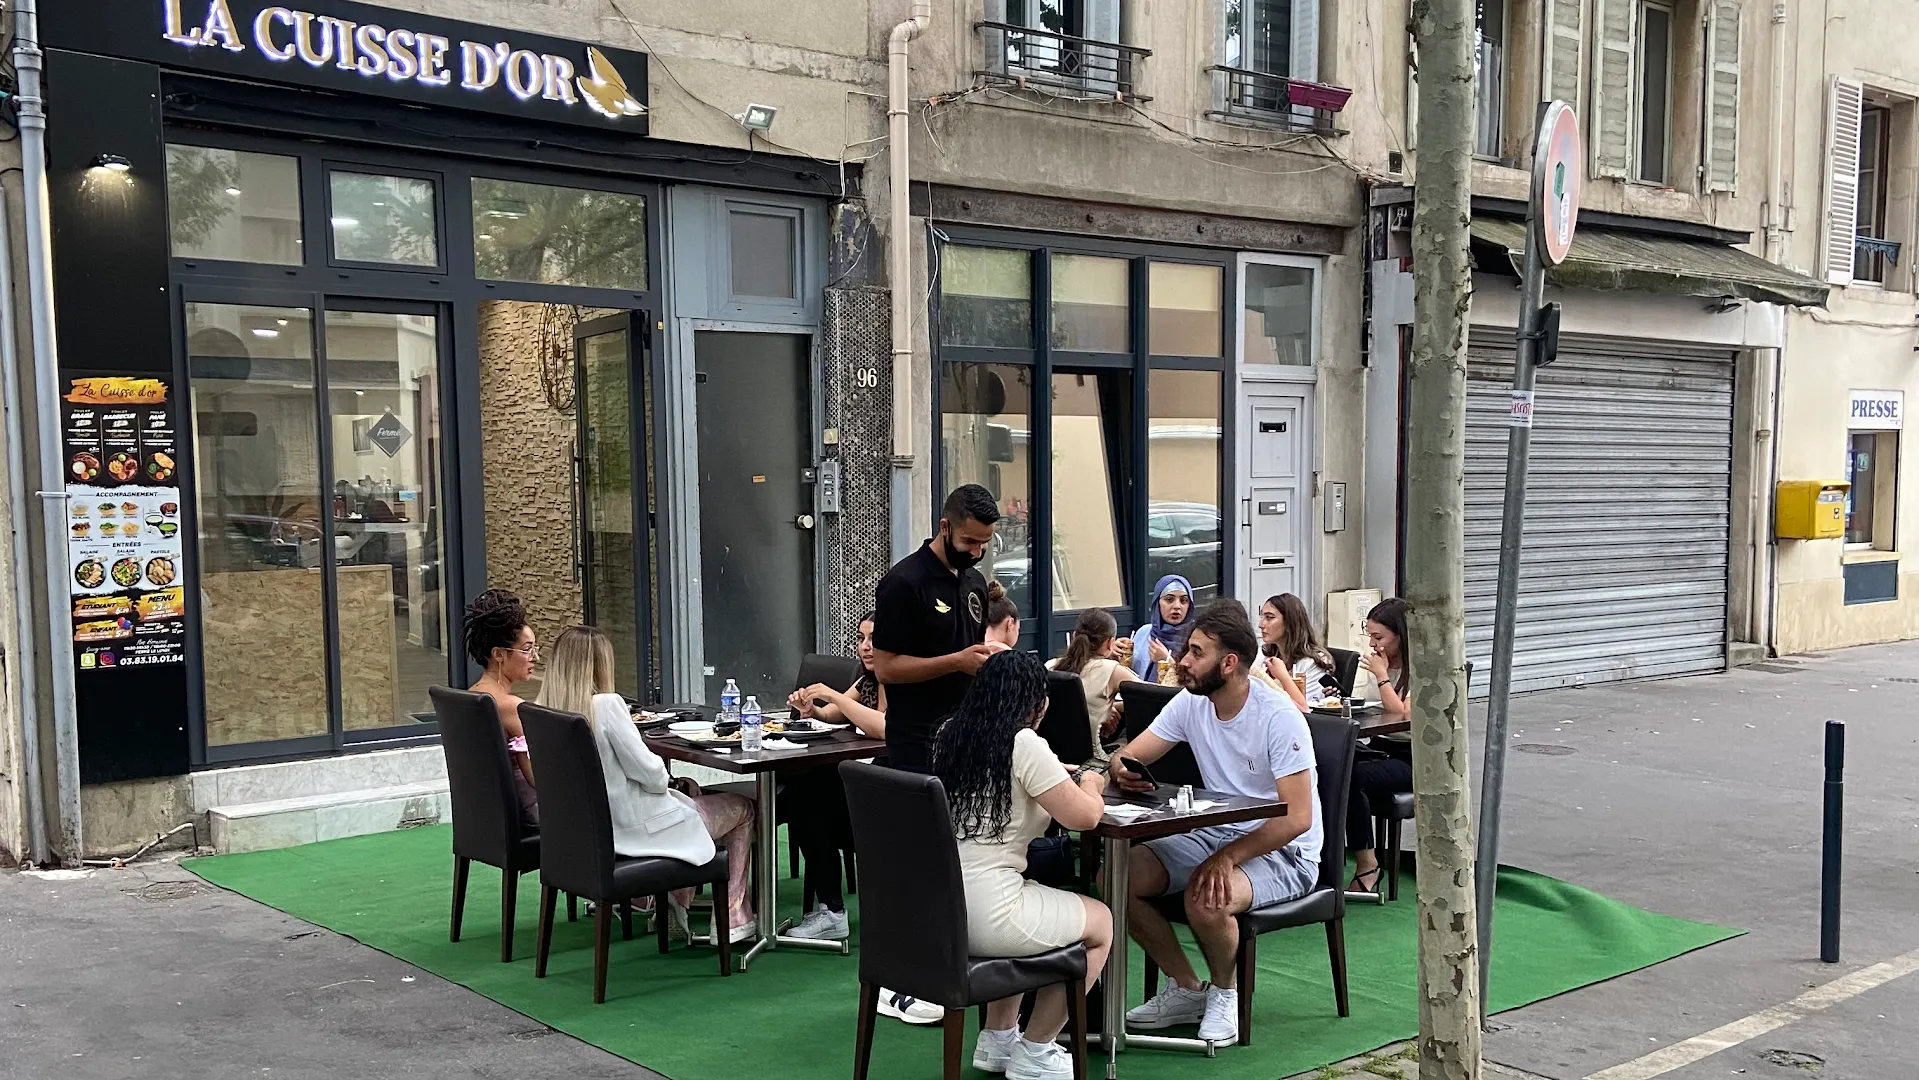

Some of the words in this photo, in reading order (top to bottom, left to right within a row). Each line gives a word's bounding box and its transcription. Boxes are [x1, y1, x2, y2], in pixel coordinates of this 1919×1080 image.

[162, 0, 245, 51] LA
[252, 5, 452, 86] CUISSE
[460, 40, 579, 104] D'OR
[857, 367, 878, 388] 96
[80, 383, 97, 398] La
[100, 383, 135, 398] Cuisse
[1851, 399, 1899, 418] PRESSE
[148, 594, 176, 603] MENU
[120, 654, 184, 666] 03.83.19.01.84
